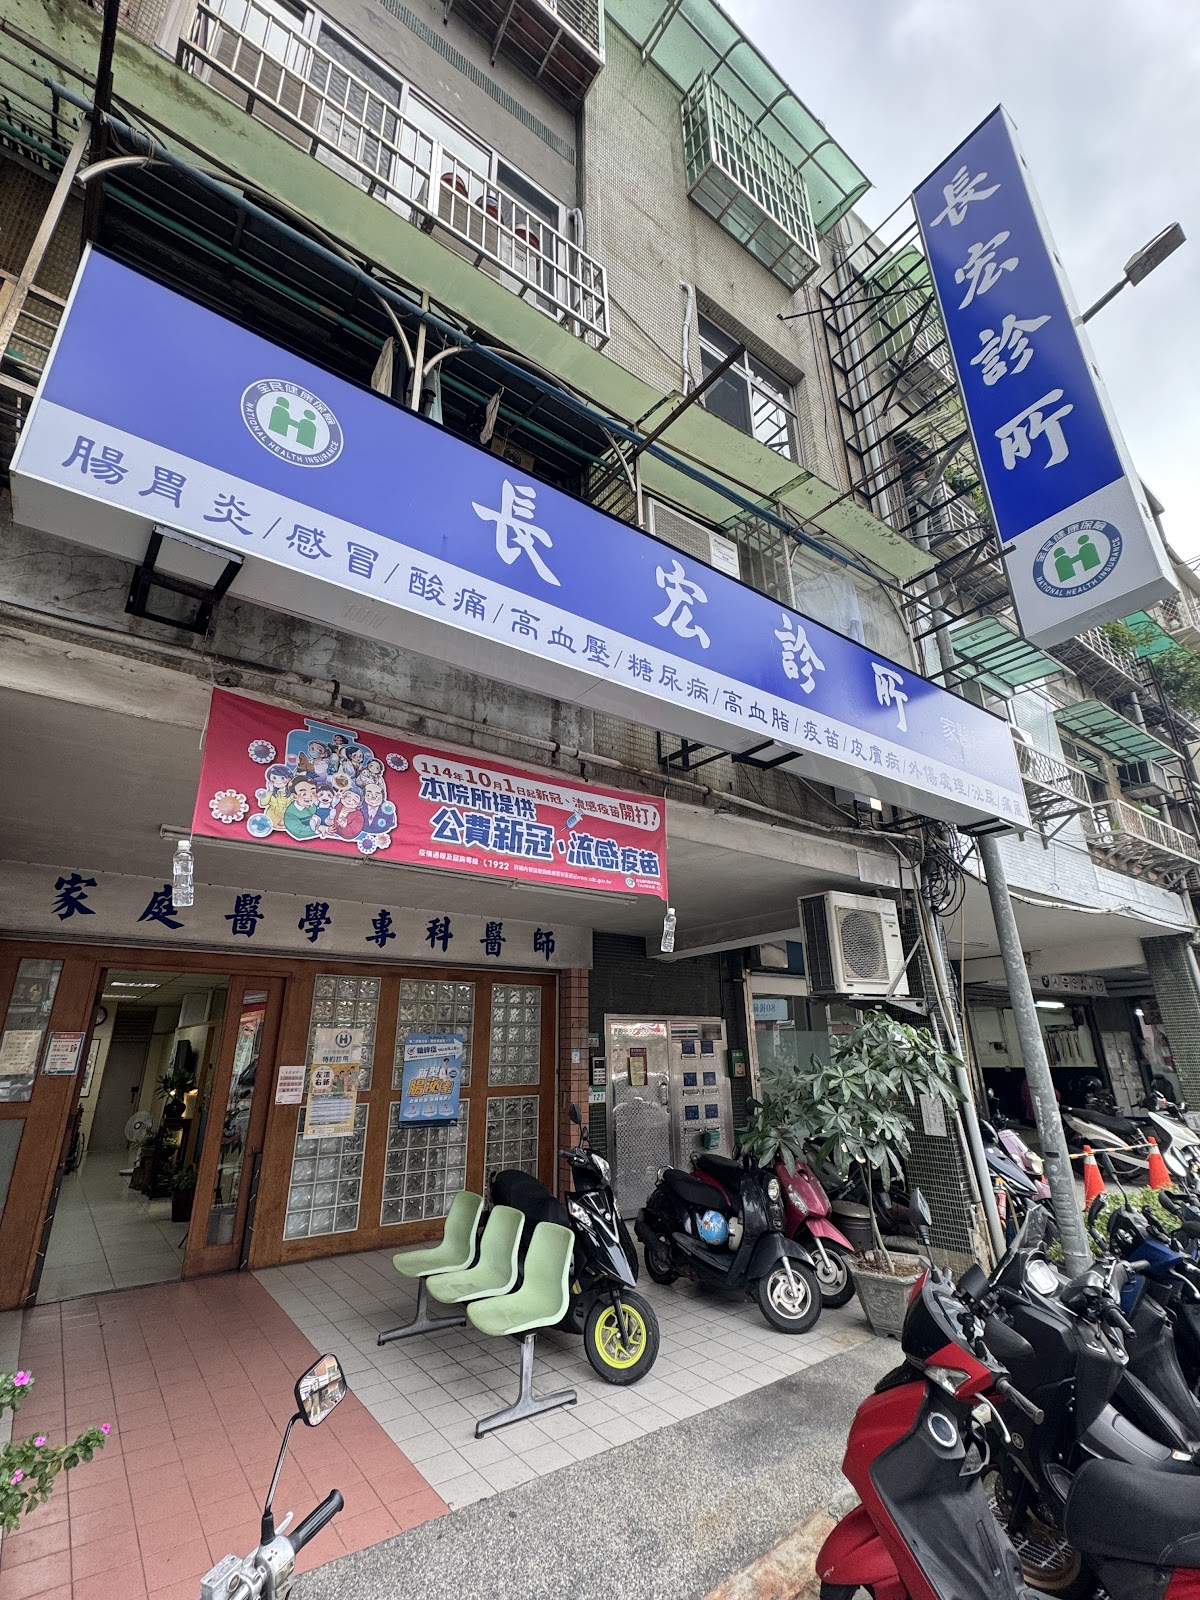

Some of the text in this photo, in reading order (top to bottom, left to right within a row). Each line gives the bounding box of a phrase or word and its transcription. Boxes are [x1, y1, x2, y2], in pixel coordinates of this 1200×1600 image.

[930, 165, 1073, 471] 長宏診所
[246, 401, 339, 464] NATIONAL HEALTH INSURANCE
[1036, 536, 1120, 596] NATIONAL HEALTH INSURANCE
[472, 479, 907, 732] 長宏診所
[419, 776, 536, 820] 本院所提供
[488, 860, 509, 871] 1922
[51, 873, 555, 961] 家庭醫學專科醫師
[593, 1093, 604, 1101] 121
